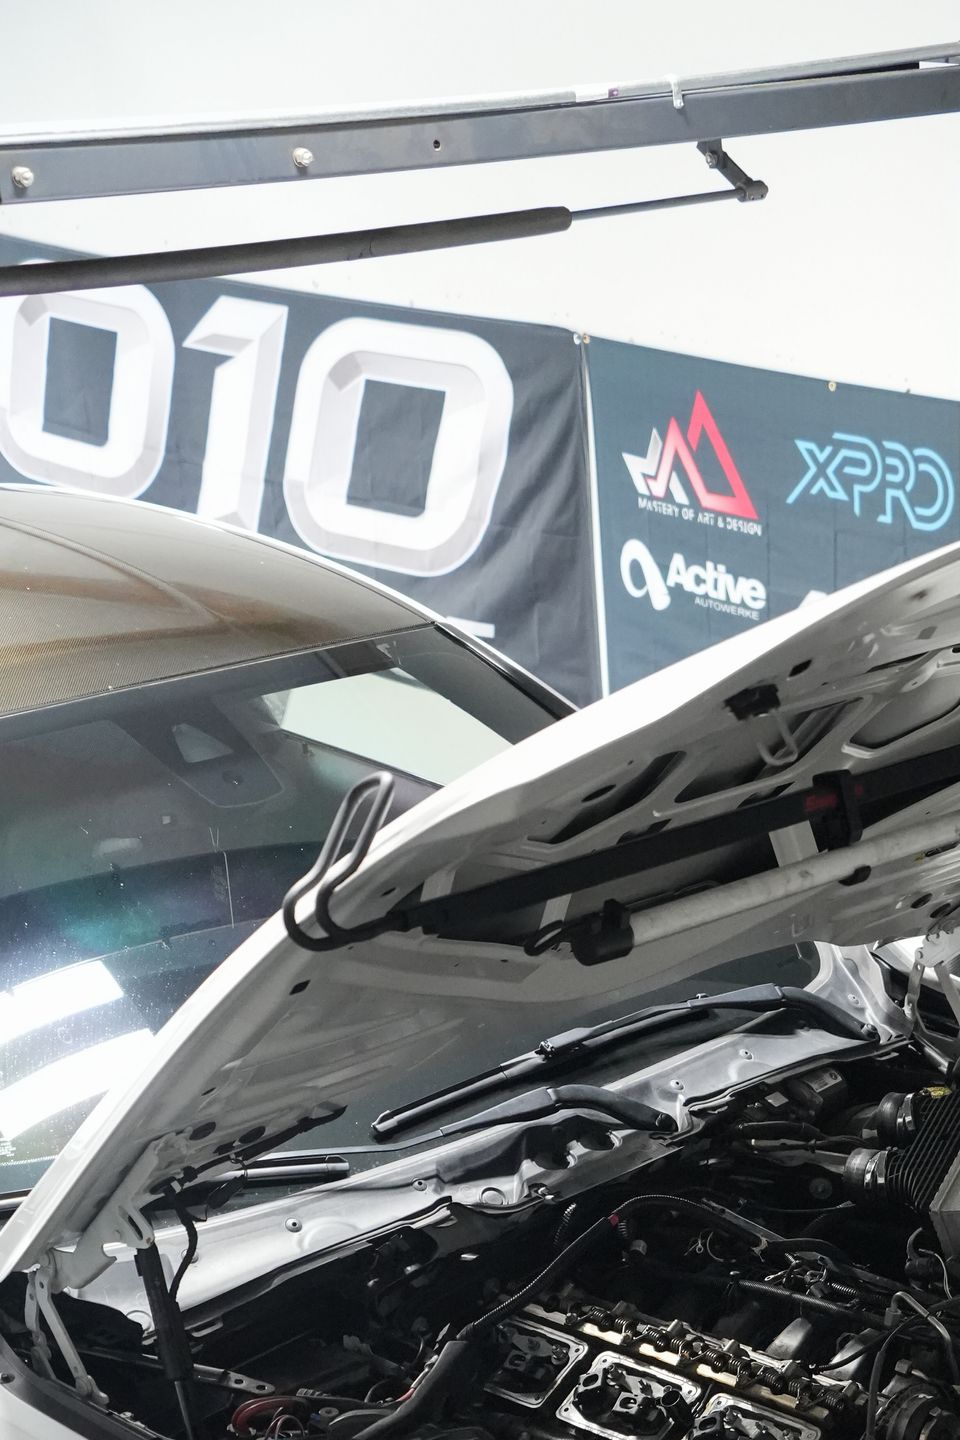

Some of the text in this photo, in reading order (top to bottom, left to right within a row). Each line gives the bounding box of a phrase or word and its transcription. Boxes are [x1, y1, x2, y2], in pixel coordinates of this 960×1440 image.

[785, 432, 955, 531] XPRO
[637, 496, 762, 537] MASTERY OF ART & DESIGN
[666, 552, 767, 610] Active
[694, 597, 760, 621] AUTOWERKE
